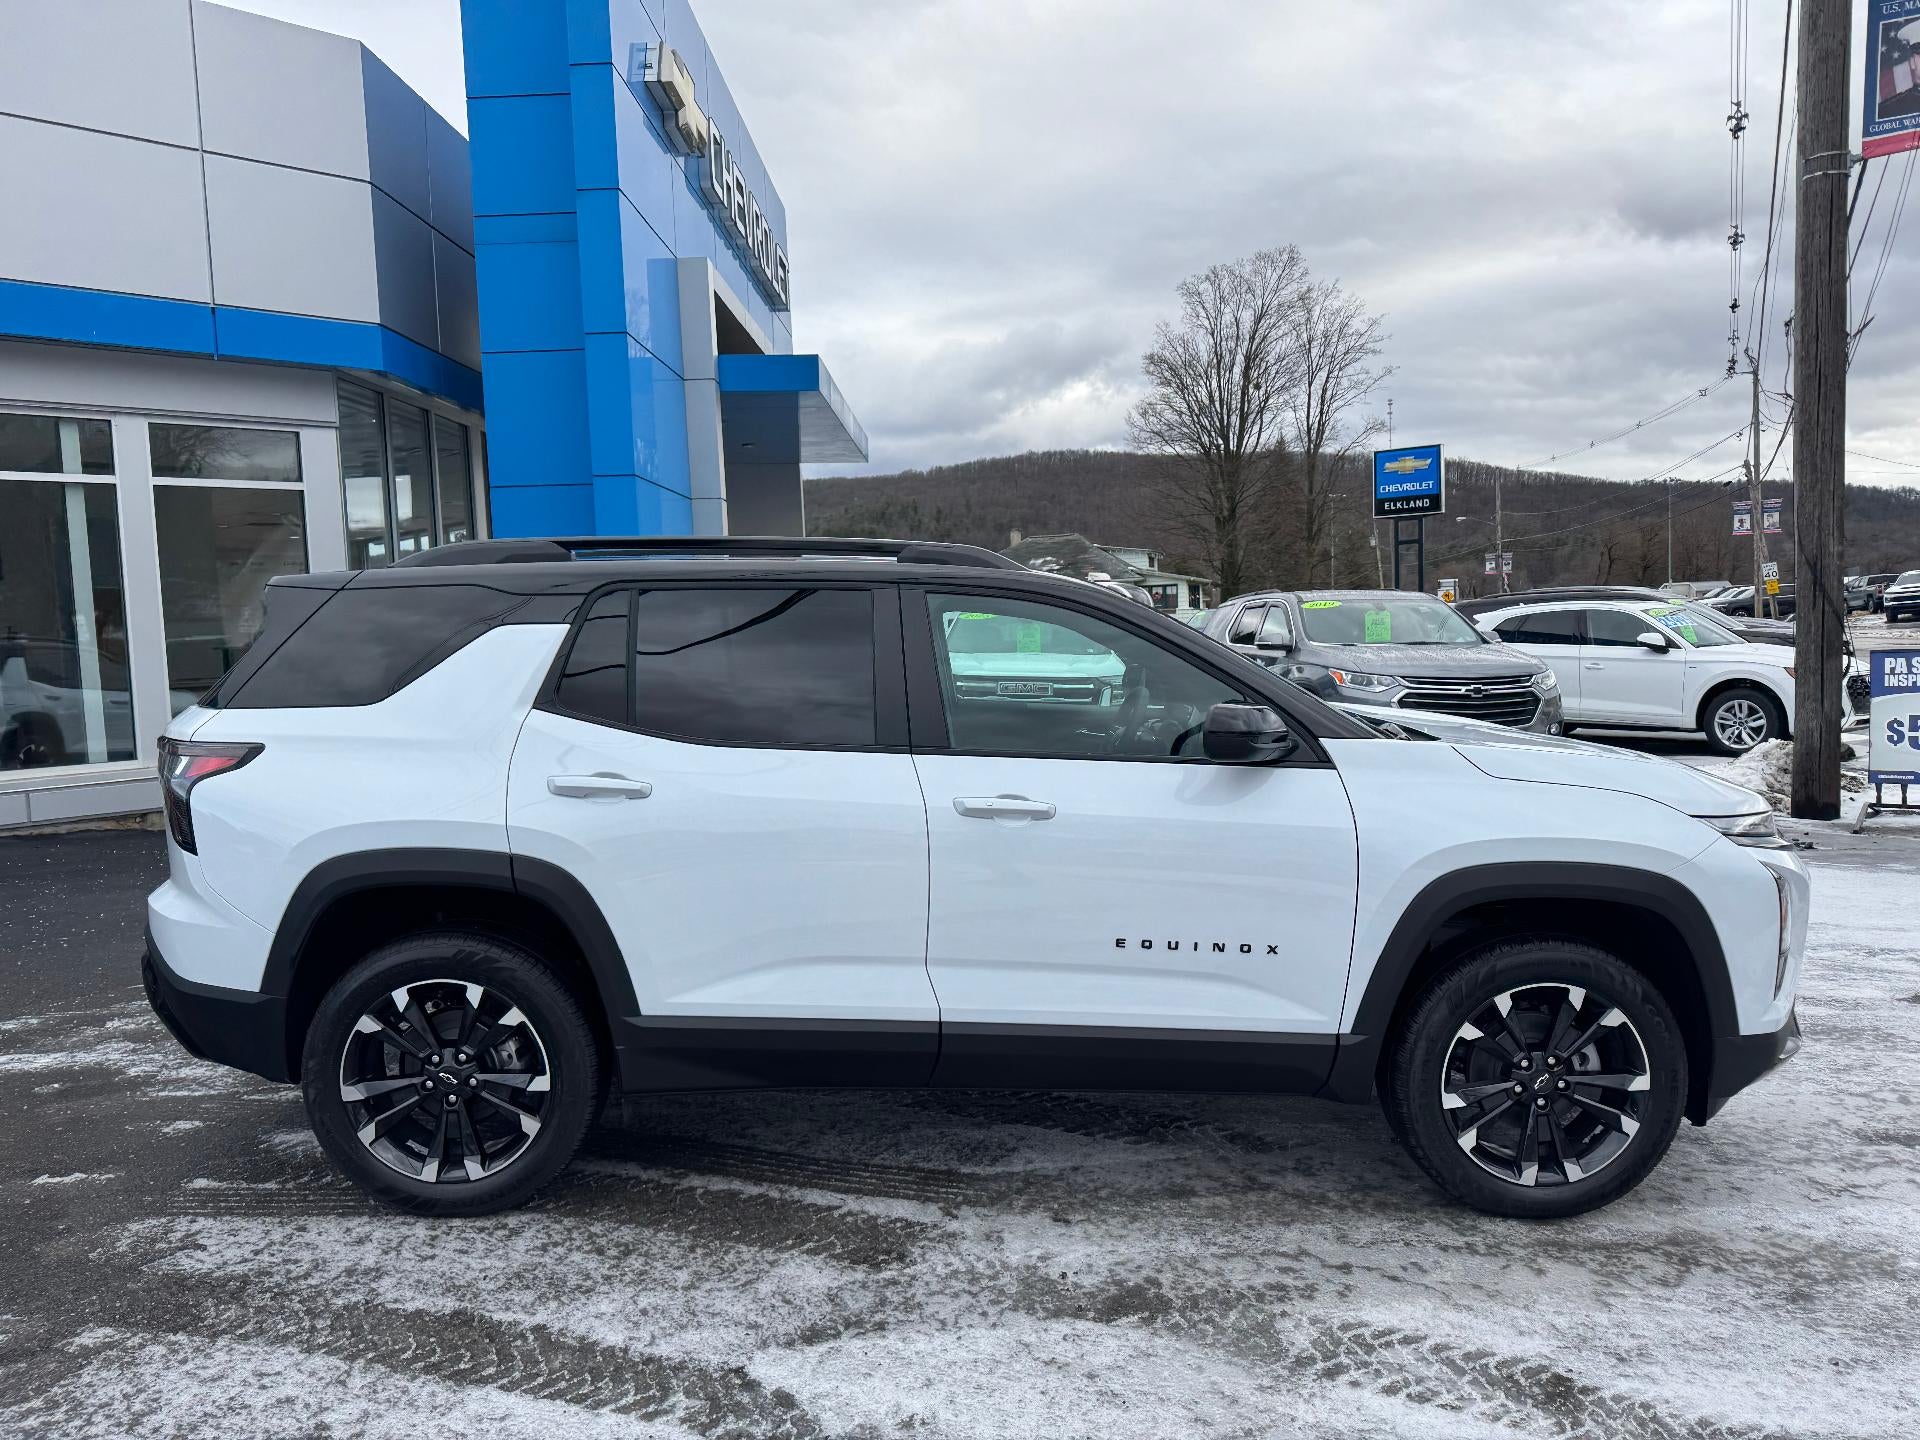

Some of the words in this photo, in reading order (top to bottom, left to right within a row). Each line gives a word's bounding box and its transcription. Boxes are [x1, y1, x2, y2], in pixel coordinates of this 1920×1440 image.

[1882, 4, 1901, 15] U.S.
[1869, 120, 1902, 133] GLOBAL
[706, 116, 791, 312] CHEVROLET
[1380, 480, 1434, 493] CHEVROLET
[1384, 498, 1430, 510] ELKLAND
[1884, 657, 1908, 674] PA
[1000, 682, 1050, 694] GMC
[1115, 938, 1279, 955] EQUINOX
